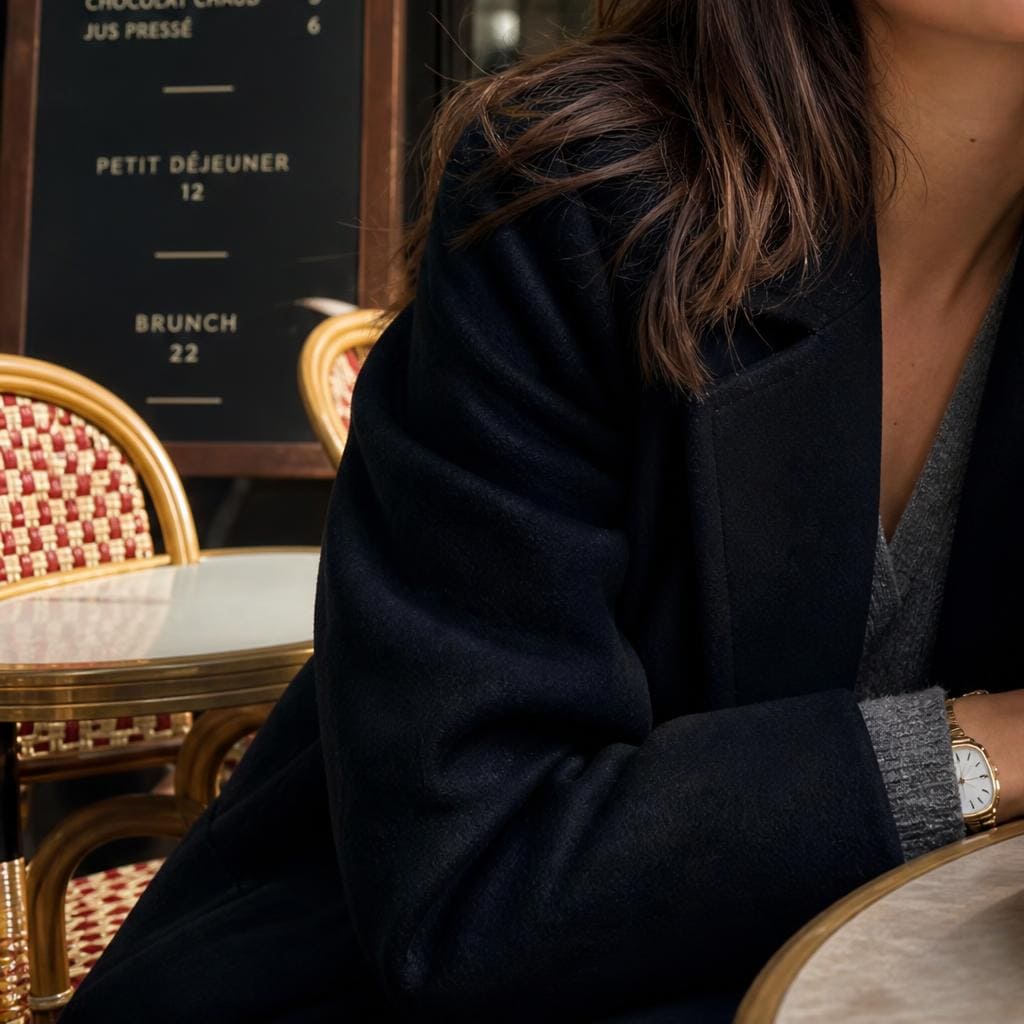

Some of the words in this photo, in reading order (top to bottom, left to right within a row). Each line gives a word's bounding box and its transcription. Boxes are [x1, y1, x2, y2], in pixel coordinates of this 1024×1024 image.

[83, 21, 120, 41] JUS
[124, 15, 193, 40] PRESSÉ
[306, 15, 322, 35] 6
[96, 155, 161, 176] PETIT
[169, 150, 290, 174] DÉJEUNER
[181, 182, 204, 202] 12
[135, 312, 238, 334] BRUNCH
[168, 342, 199, 364] 22
